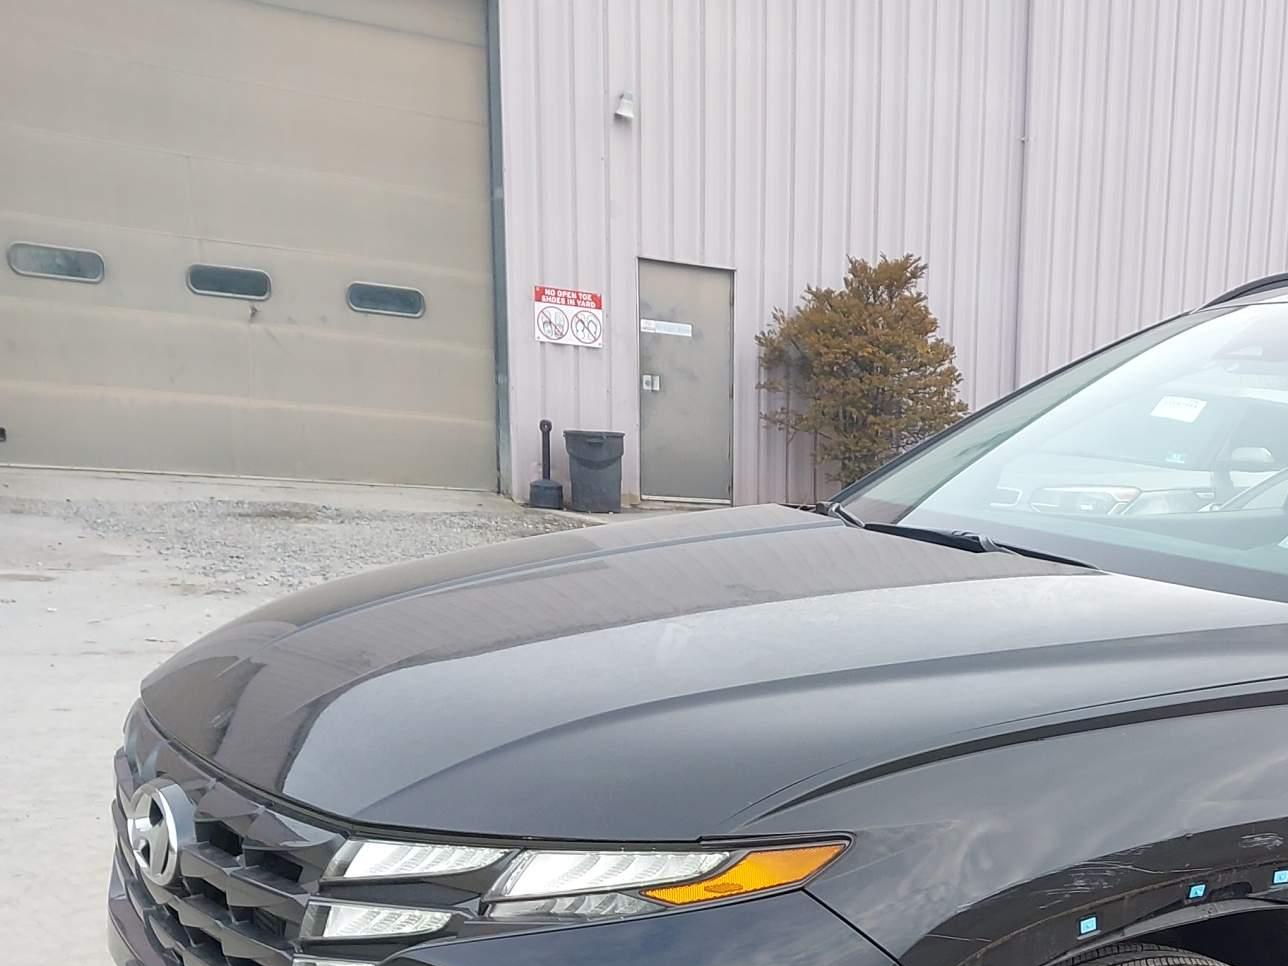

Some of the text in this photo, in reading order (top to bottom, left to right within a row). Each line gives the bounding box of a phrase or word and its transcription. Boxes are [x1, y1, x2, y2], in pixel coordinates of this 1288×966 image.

[544, 288, 592, 301] NO OPEN TOE
[541, 295, 566, 304] SHOES
[577, 300, 596, 308] YARD
